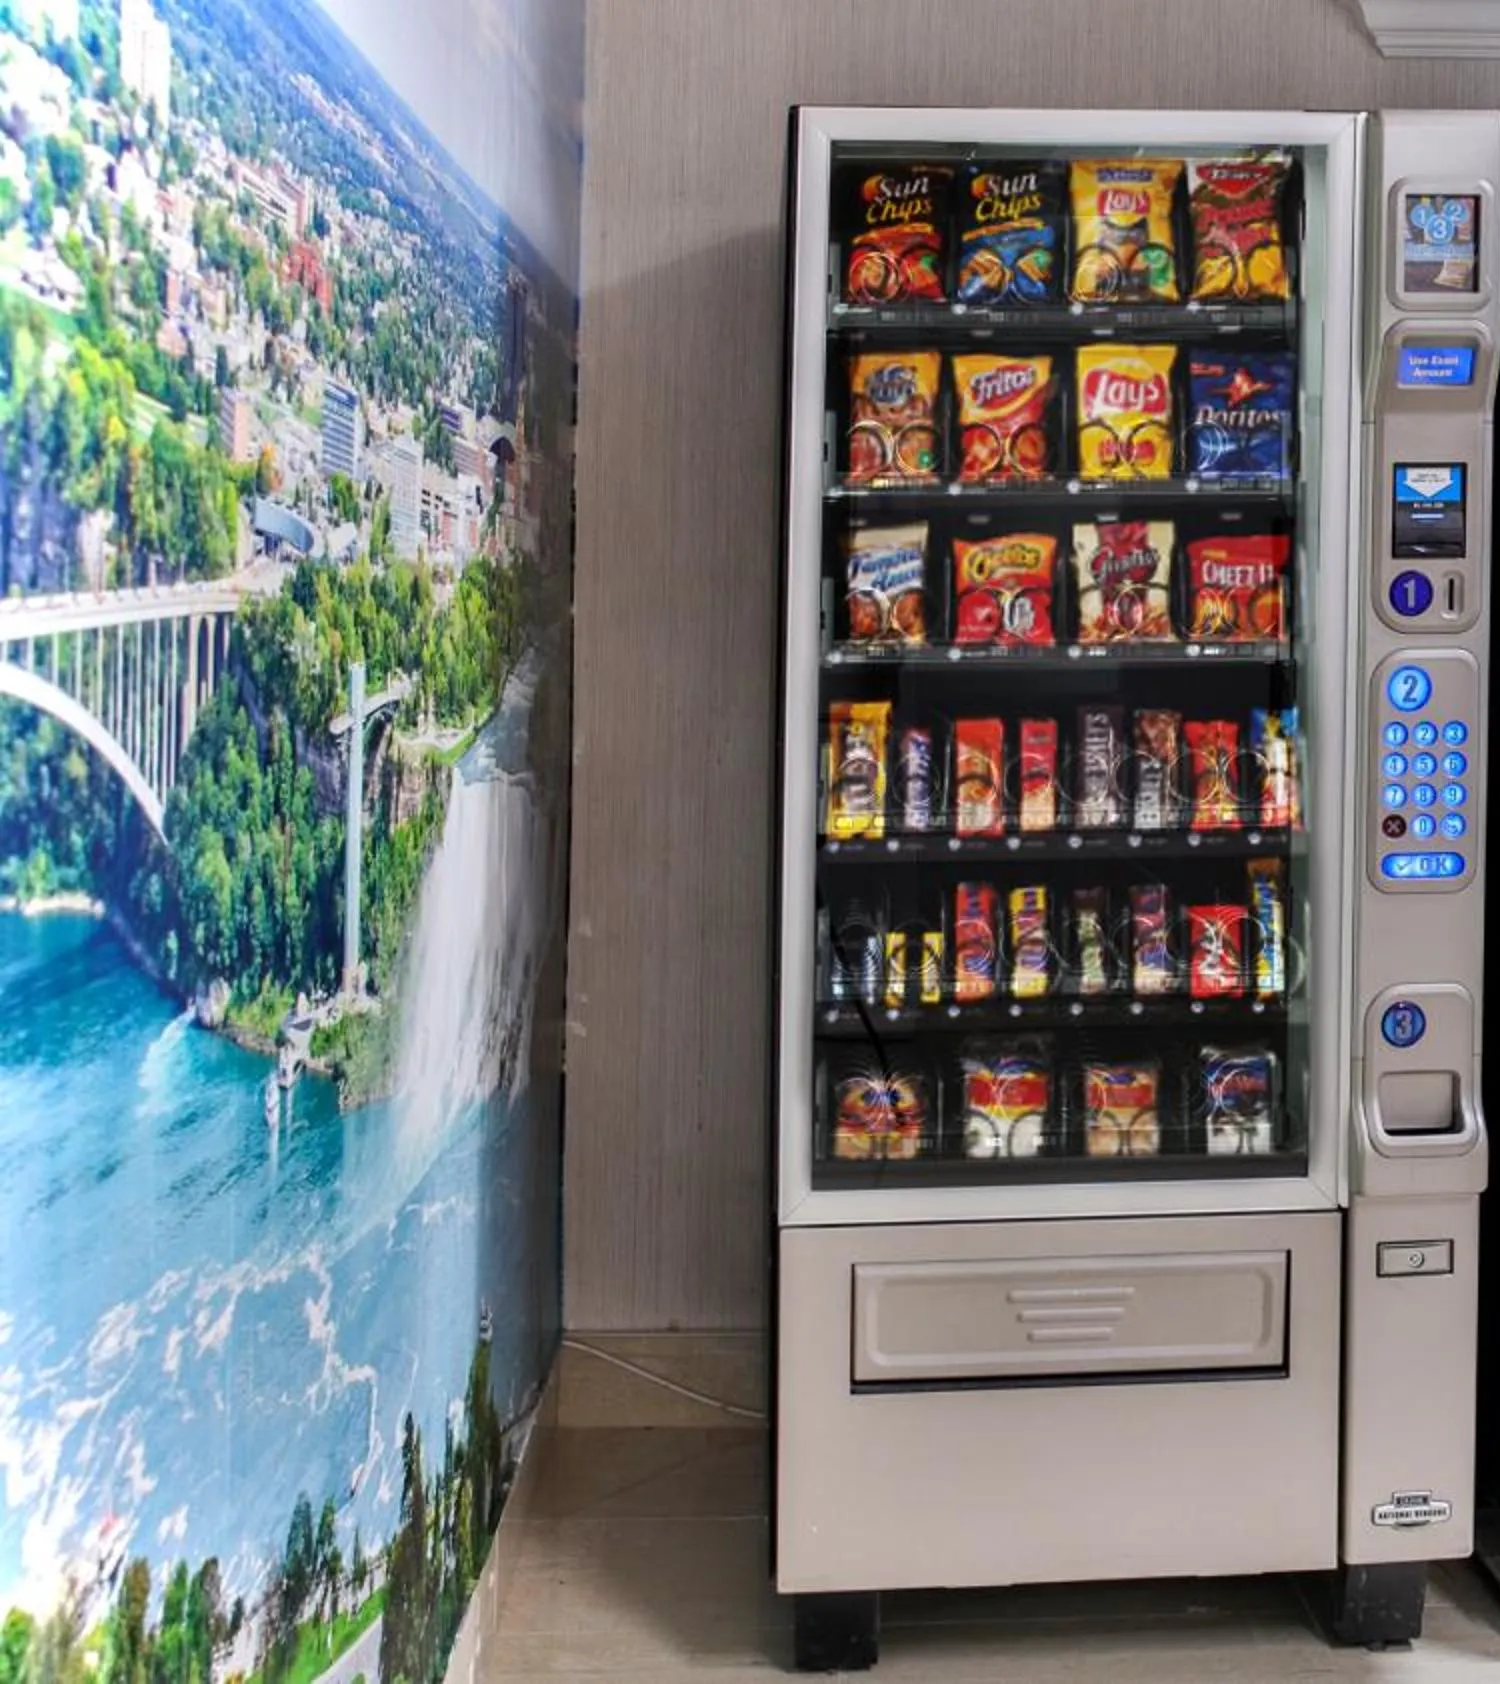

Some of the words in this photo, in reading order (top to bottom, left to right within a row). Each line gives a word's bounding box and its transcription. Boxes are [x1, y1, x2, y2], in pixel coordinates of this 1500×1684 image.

[879, 176, 929, 198] Sun
[987, 173, 1039, 196] Sun
[865, 197, 933, 224] Chips
[975, 192, 1042, 222] Chips
[1432, 218, 1448, 238] 3
[1195, 404, 1281, 428] Doritos
[1403, 578, 1417, 609] 1
[1402, 674, 1418, 703] 2
[1419, 856, 1448, 872] OK
[1394, 1010, 1413, 1039] 3
